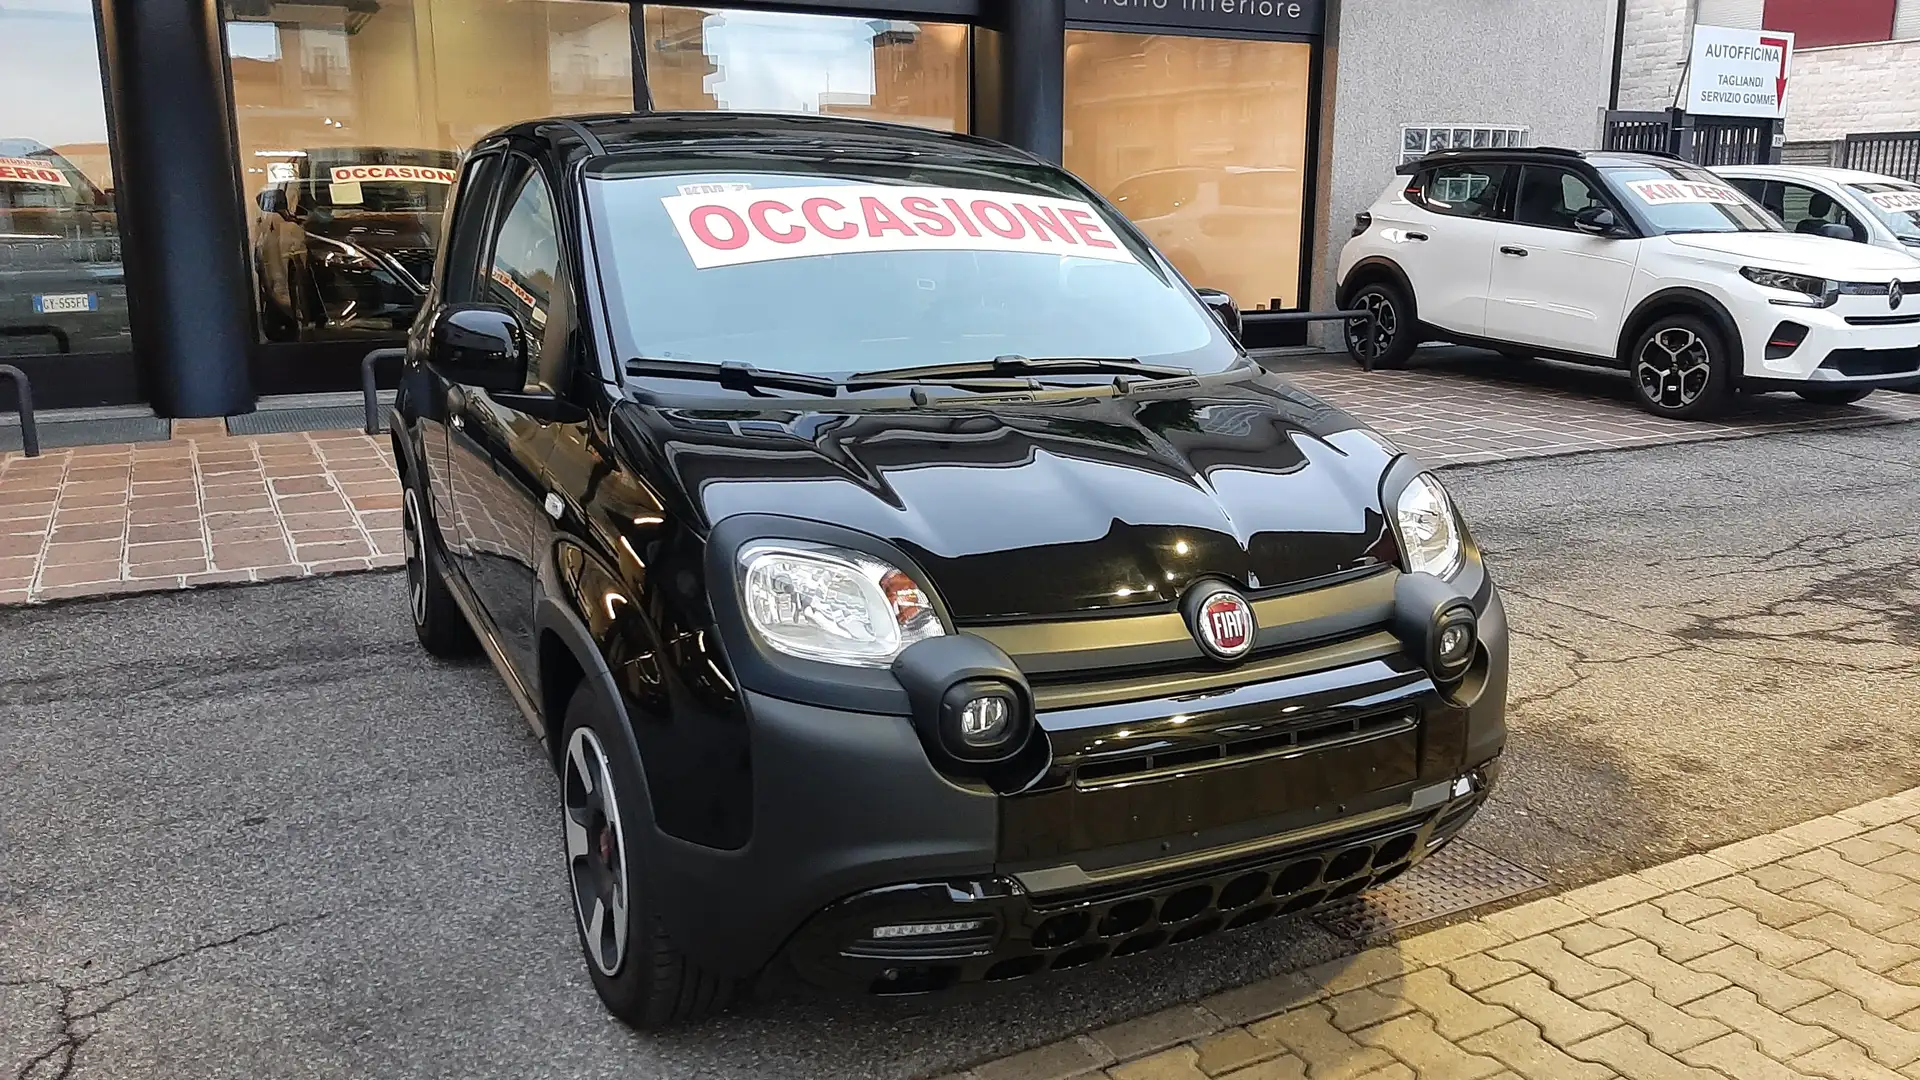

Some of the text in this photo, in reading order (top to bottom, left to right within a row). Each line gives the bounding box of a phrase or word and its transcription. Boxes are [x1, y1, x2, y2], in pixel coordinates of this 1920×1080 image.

[1705, 43, 1780, 63] AUTOFFICINA
[1718, 74, 1764, 88] TAGLIANDI
[1701, 90, 1776, 106] SERVIZIO GOMME
[335, 167, 457, 183] OCCASION
[1637, 183, 1687, 200] KM
[689, 196, 1118, 251] OCCASIONE
[1212, 609, 1244, 640] FIAT
